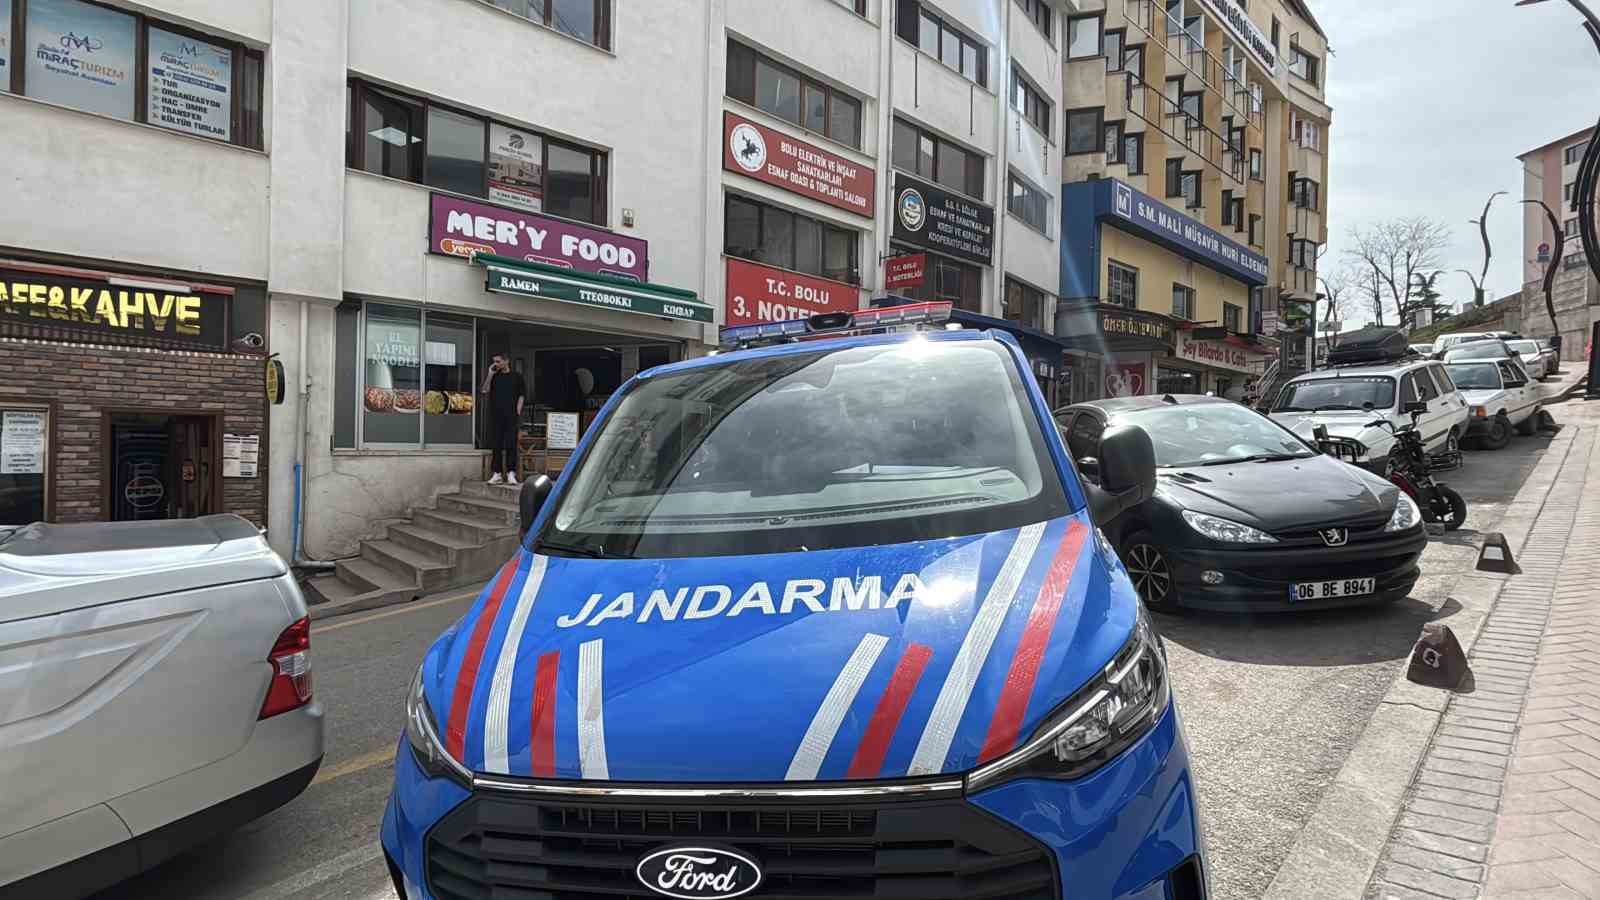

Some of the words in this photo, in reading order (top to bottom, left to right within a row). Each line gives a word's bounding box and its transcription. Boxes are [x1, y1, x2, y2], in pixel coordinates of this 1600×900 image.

[161, 79, 178, 88] TUR
[161, 97, 178, 106] HAC
[161, 105, 202, 121] TRANSFER
[161, 114, 192, 128] KÜLTÜR
[193, 121, 225, 136] TURLARI
[781, 141, 797, 158] BOLU
[798, 148, 827, 169] ELEKTRİK
[827, 160, 836, 172] VE
[768, 163, 789, 180] ESNAF
[790, 172, 809, 188] ODASI
[797, 160, 842, 187] SANATKARLARI
[929, 205, 947, 219] ESNAF
[1138, 201, 1156, 223] S.M.
[1158, 209, 1182, 236] MALİ
[446, 209, 548, 250] MER'Y
[561, 234, 636, 269] FOOD
[500, 276, 540, 293] RAMEN
[765, 278, 791, 297] T.C.
[794, 285, 829, 305] BOLU
[578, 289, 632, 308] TTEOBOKKI
[733, 295, 751, 318] 3.
[556, 572, 929, 628] JANDARMA
[1299, 584, 1314, 598] 06
[1322, 582, 1338, 597] BE
[1343, 579, 1373, 594] 8941
[657, 854, 738, 892] Ford
